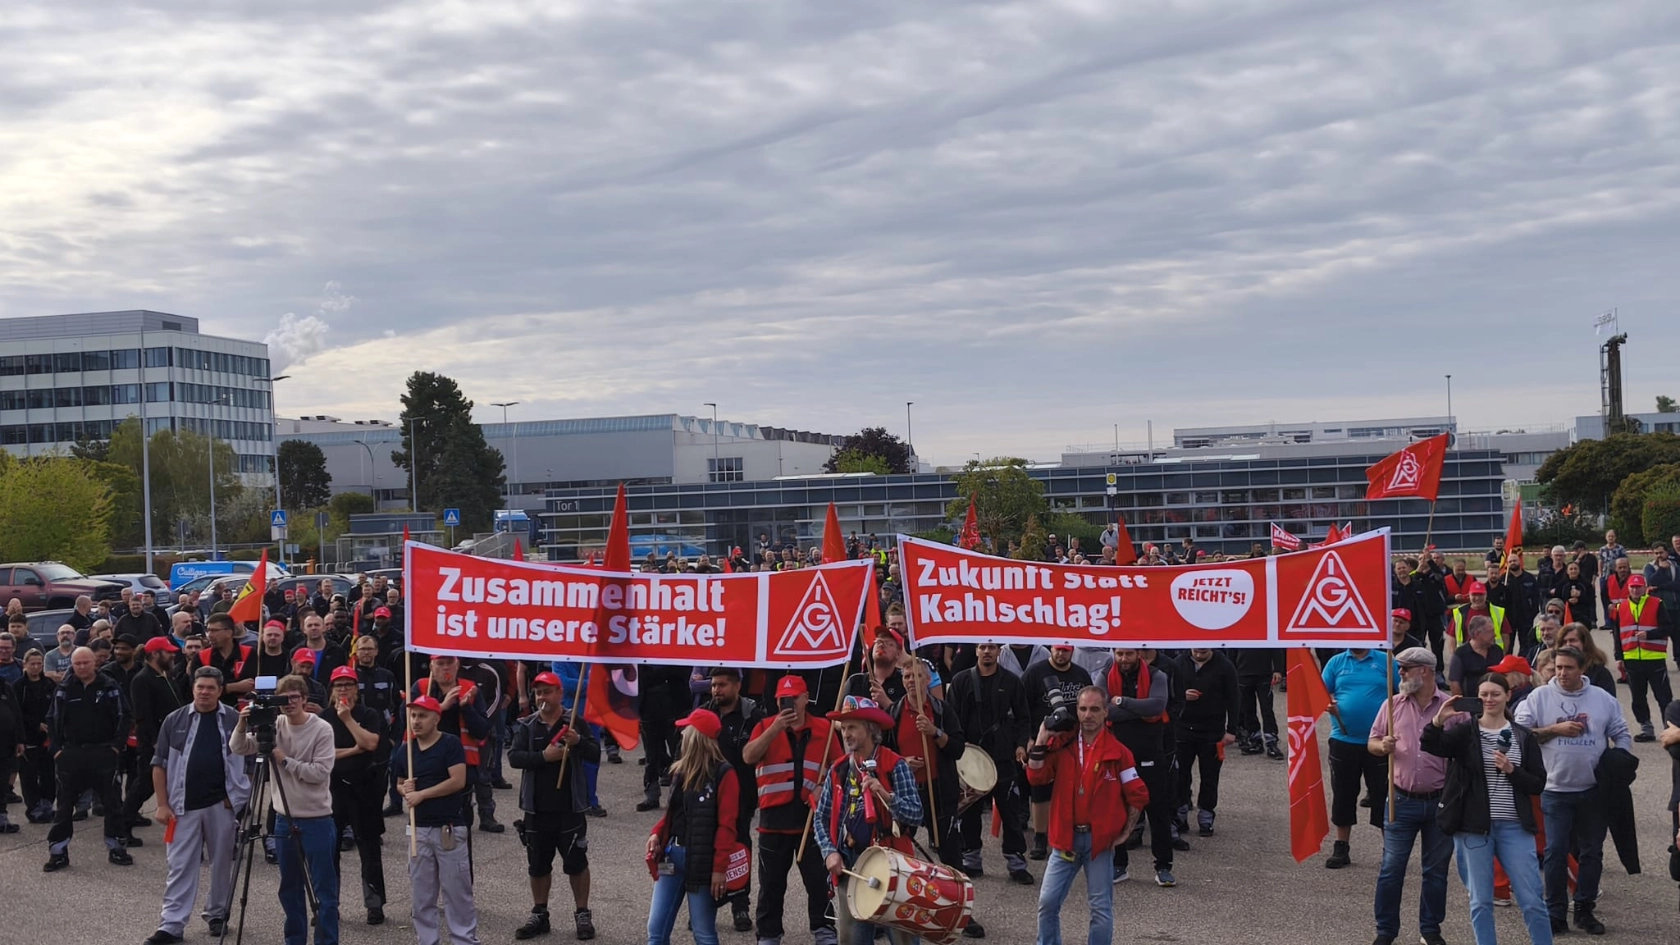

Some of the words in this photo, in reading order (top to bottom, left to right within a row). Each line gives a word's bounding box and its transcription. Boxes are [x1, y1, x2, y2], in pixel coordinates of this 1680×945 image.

[556, 501, 572, 511] Tor
[574, 501, 578, 510] 1
[437, 566, 725, 613] Zusammenhalt
[917, 557, 1054, 591] Zukunft
[1193, 577, 1232, 588] JETZT
[436, 605, 478, 638] ist
[487, 616, 598, 643] unsere
[607, 615, 726, 647] Stärke!
[919, 592, 1122, 635] Kahlschlag!
[1558, 738, 1595, 746] FROZEN
